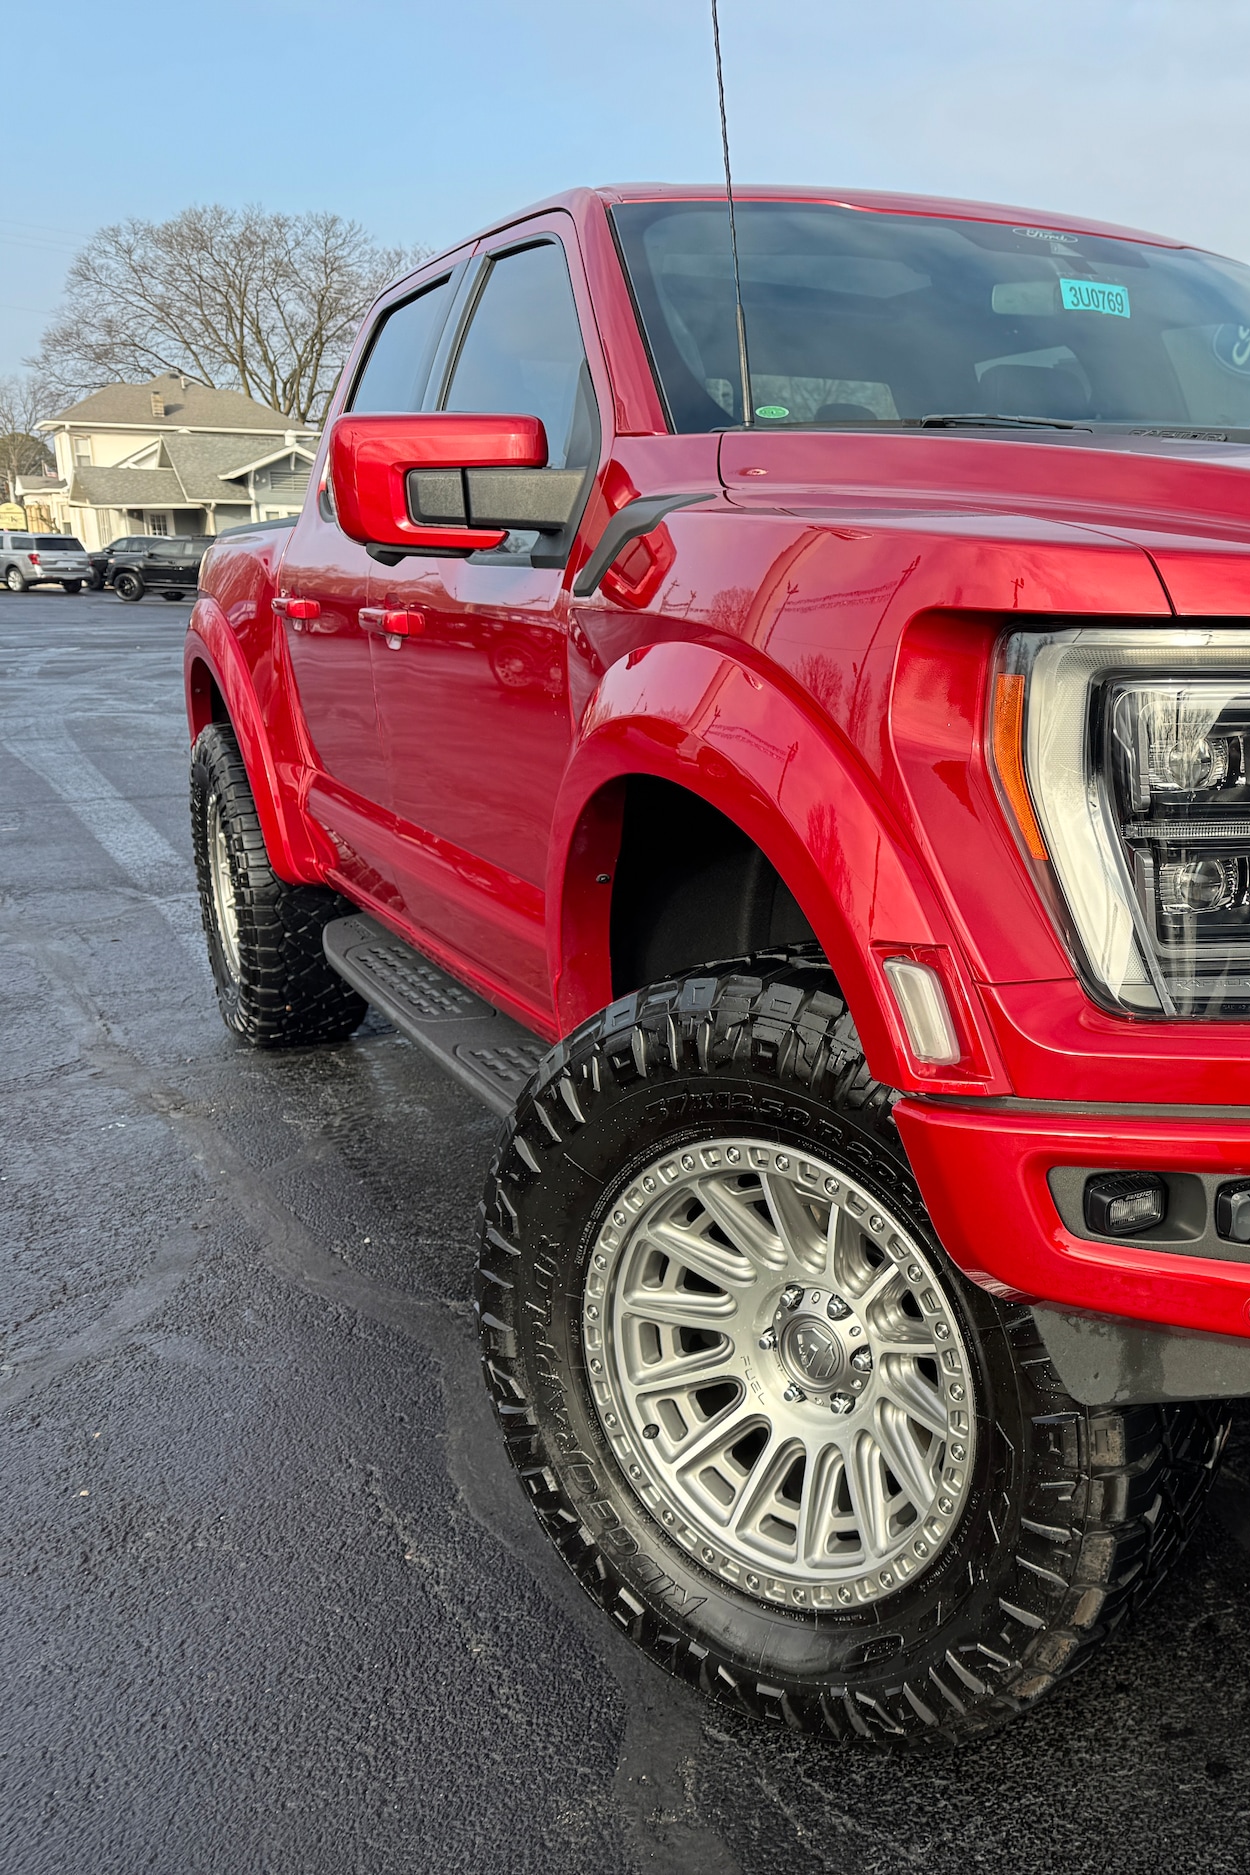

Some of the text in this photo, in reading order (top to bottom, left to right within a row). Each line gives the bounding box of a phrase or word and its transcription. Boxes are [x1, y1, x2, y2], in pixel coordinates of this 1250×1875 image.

[1024, 228, 1070, 243] Ford
[1069, 286, 1124, 314] 3U0769
[740, 1355, 765, 1406] FUEL
[588, 1500, 708, 1618] RIDGE
